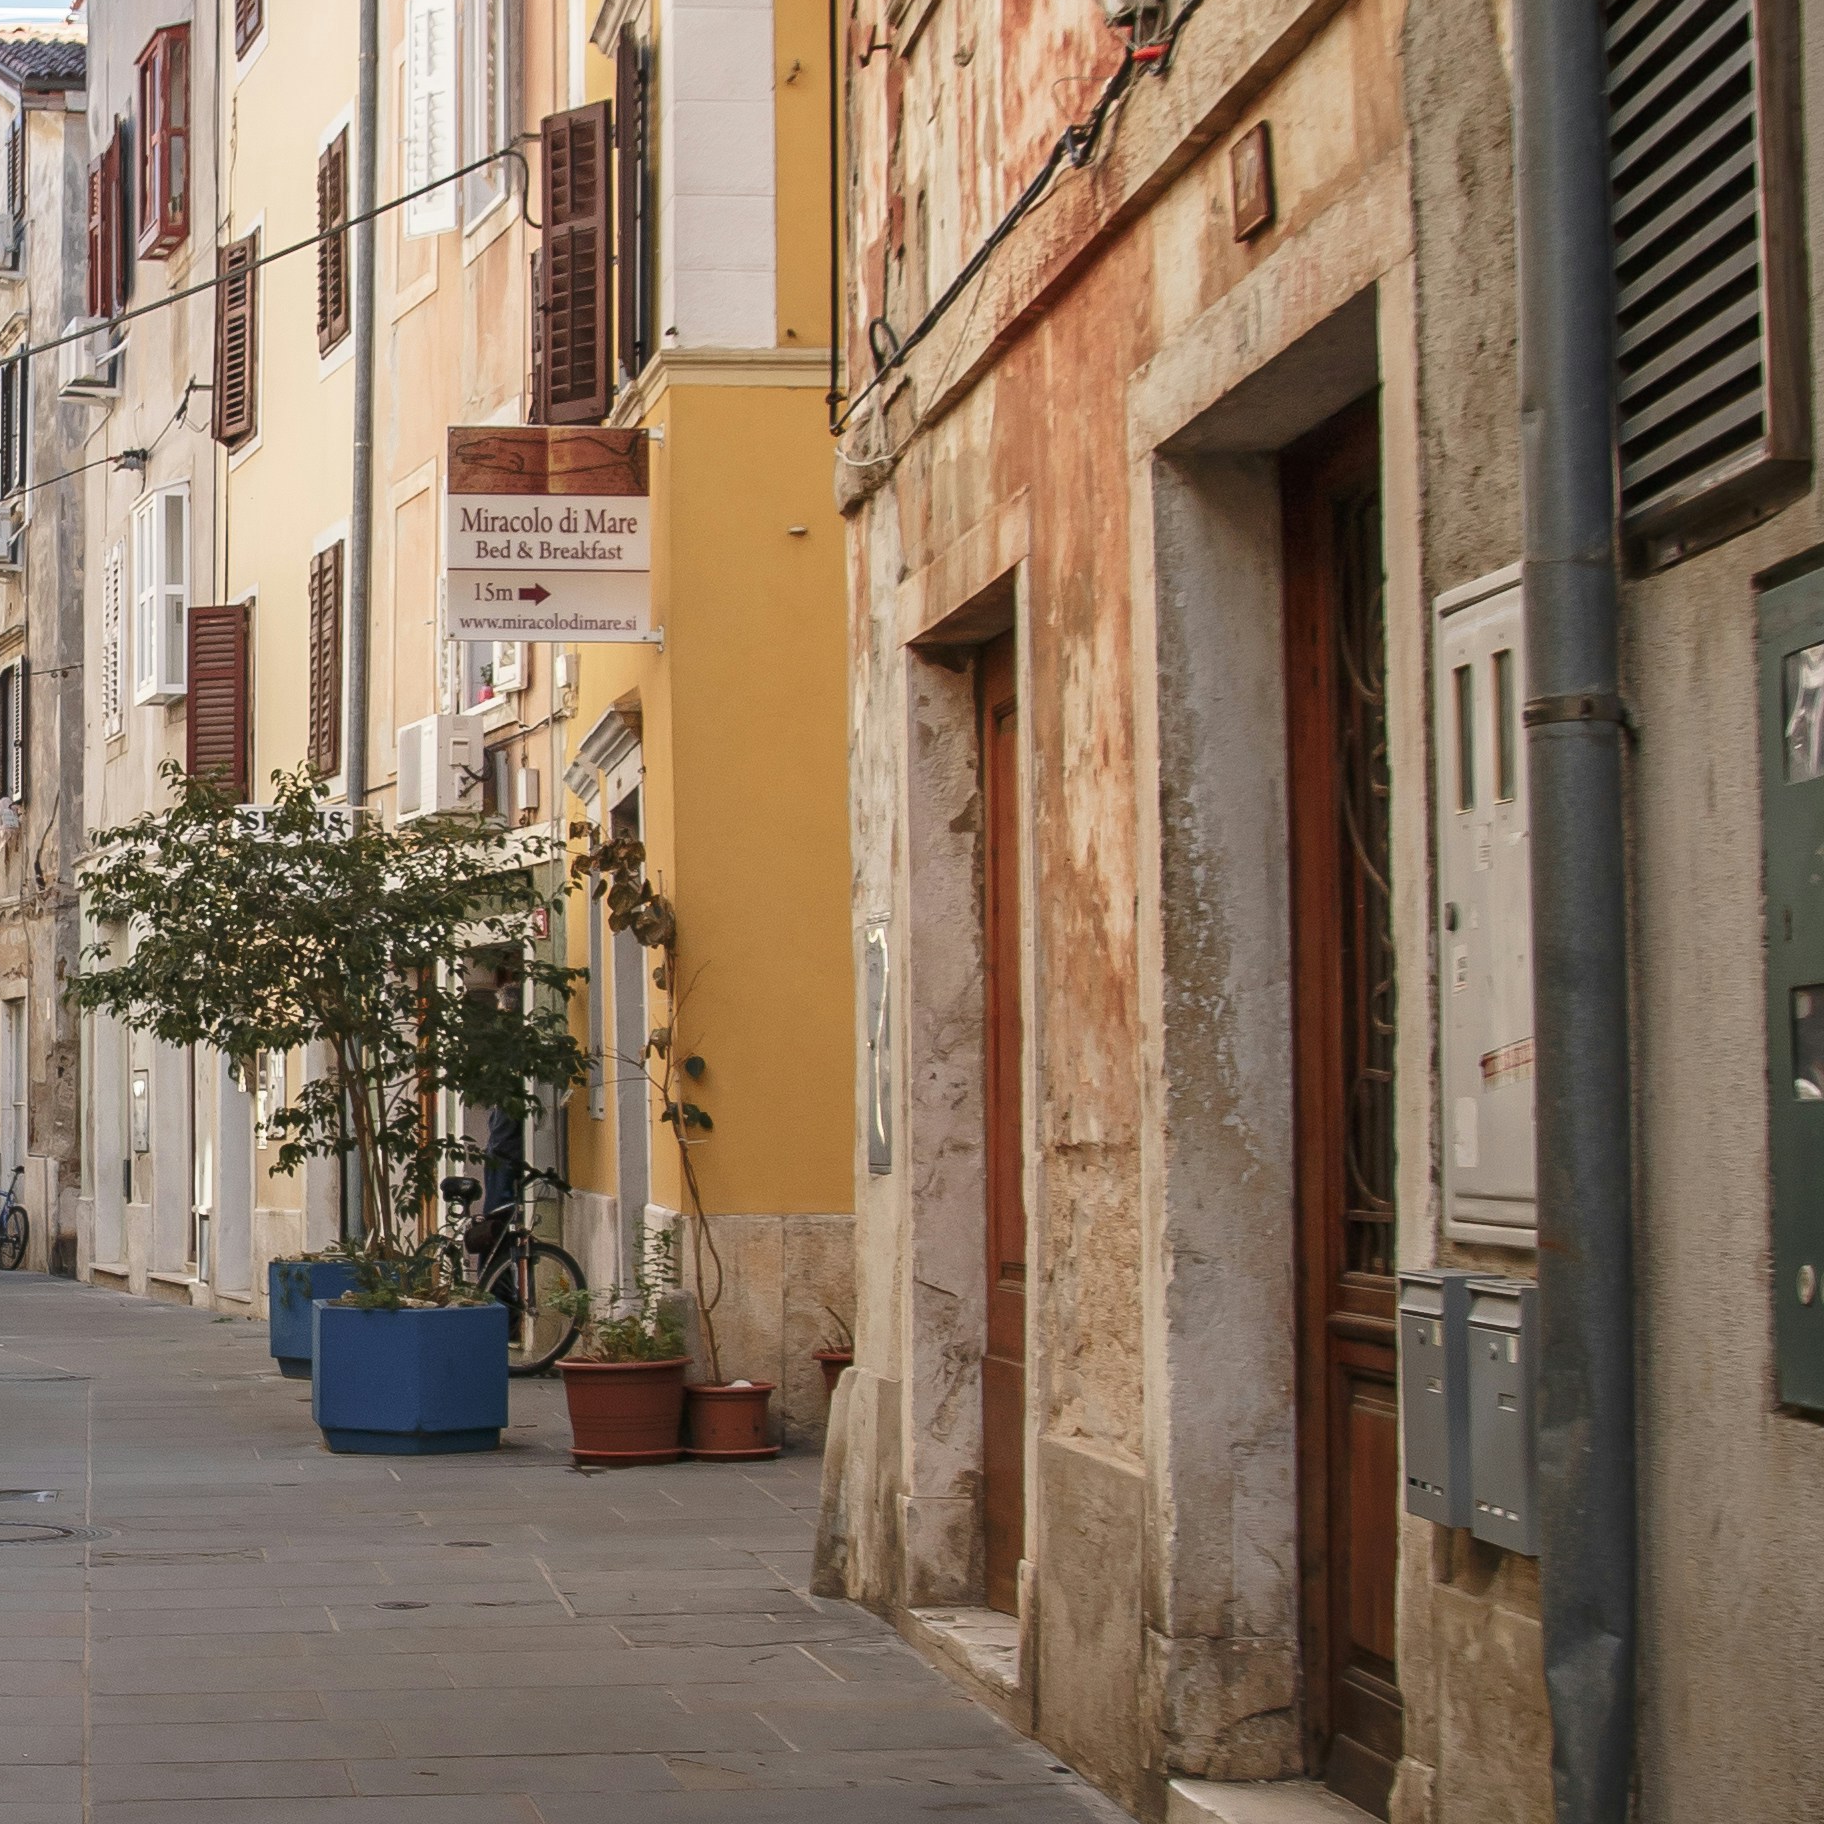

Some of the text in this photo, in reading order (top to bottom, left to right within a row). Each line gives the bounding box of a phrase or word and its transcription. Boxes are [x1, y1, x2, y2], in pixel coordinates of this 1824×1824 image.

[460, 506, 638, 534] Miracolo di Mare
[476, 540, 623, 560] Bed & Breakfast
[475, 582, 513, 601] 15m
[460, 613, 637, 631] www.miracolodimare.si
